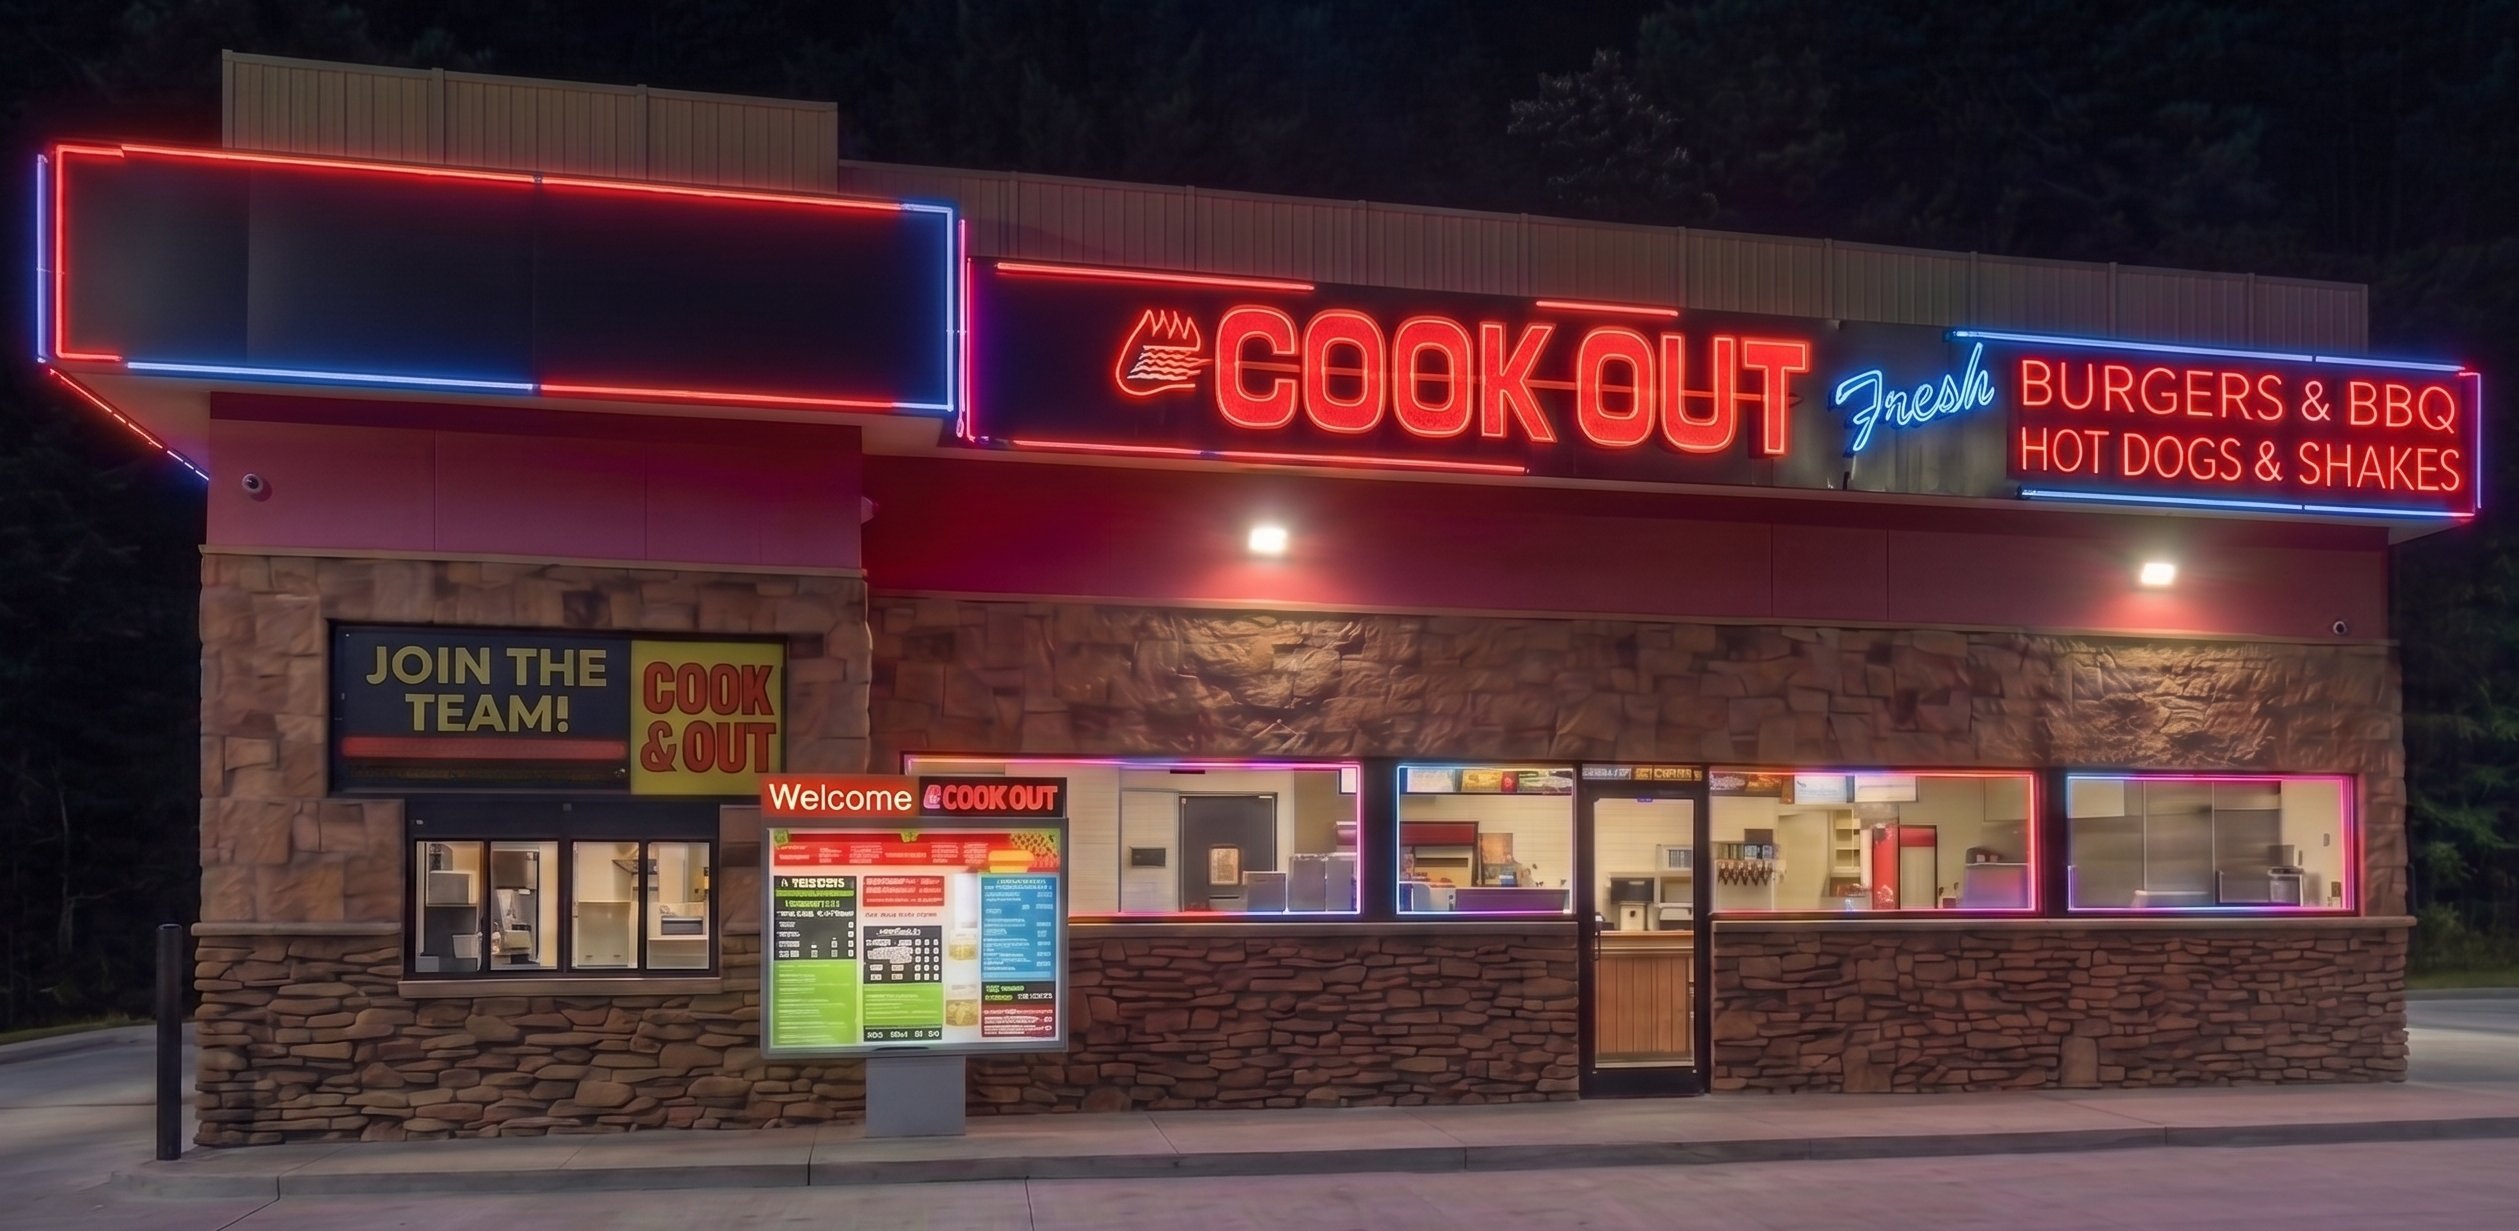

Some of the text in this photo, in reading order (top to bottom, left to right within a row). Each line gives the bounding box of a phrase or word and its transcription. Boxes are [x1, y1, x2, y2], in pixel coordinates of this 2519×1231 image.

[1214, 304, 1811, 456] COOK OUT
[1834, 342, 1995, 453] Fresh
[2020, 358, 2457, 435] BURGERS & BBQ
[2020, 426, 2460, 491] HOT DOGS & SHAKES
[365, 645, 608, 687] JOIN THE
[642, 660, 775, 717] COOK
[405, 693, 569, 734] TEAM!
[639, 720, 777, 774] & OUT
[768, 783, 913, 812] Welcome
[942, 784, 1059, 811] COOK OUT
